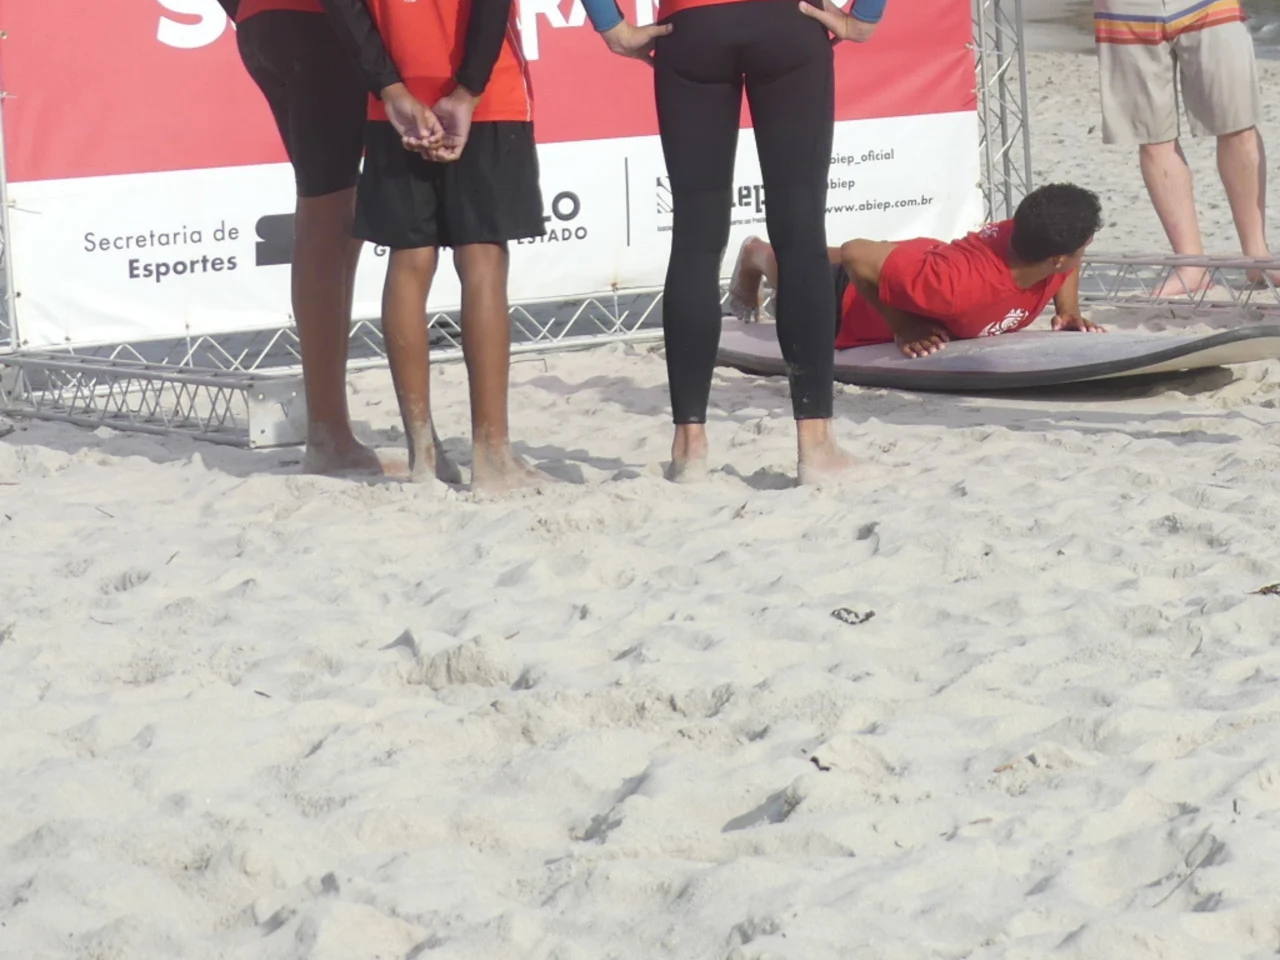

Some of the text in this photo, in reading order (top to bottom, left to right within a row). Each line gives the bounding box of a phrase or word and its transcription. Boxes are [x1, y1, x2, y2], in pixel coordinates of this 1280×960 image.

[829, 148, 895, 166] biep_oficial
[84, 220, 239, 252] Secretaria de
[128, 254, 238, 283] Esportes
